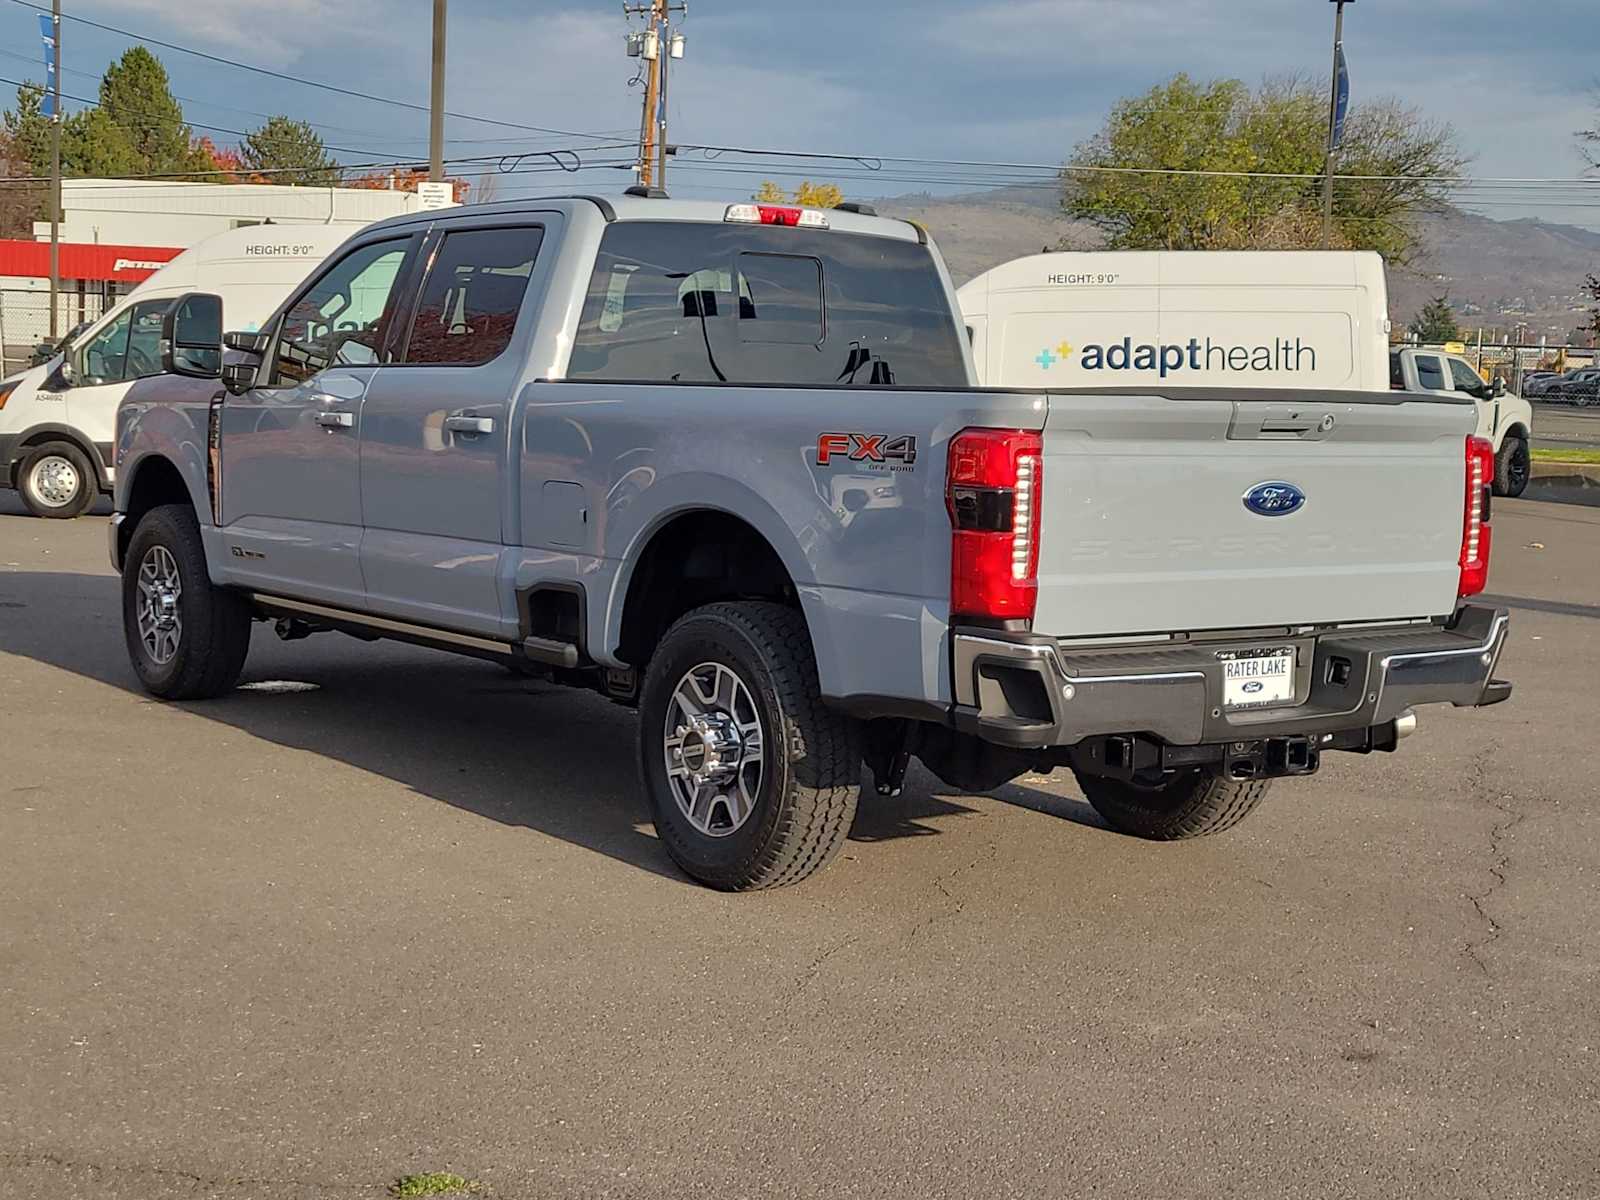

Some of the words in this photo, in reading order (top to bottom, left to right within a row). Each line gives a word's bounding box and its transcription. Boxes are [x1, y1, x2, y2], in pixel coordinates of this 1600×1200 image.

[246, 245, 290, 255] HEIGHT:
[1048, 273, 1096, 284] HEIGHT:
[1081, 336, 1316, 378] adapthealth
[816, 433, 917, 466] FX4
[1225, 661, 1259, 678] RATER
[1261, 659, 1287, 675] LAKE
